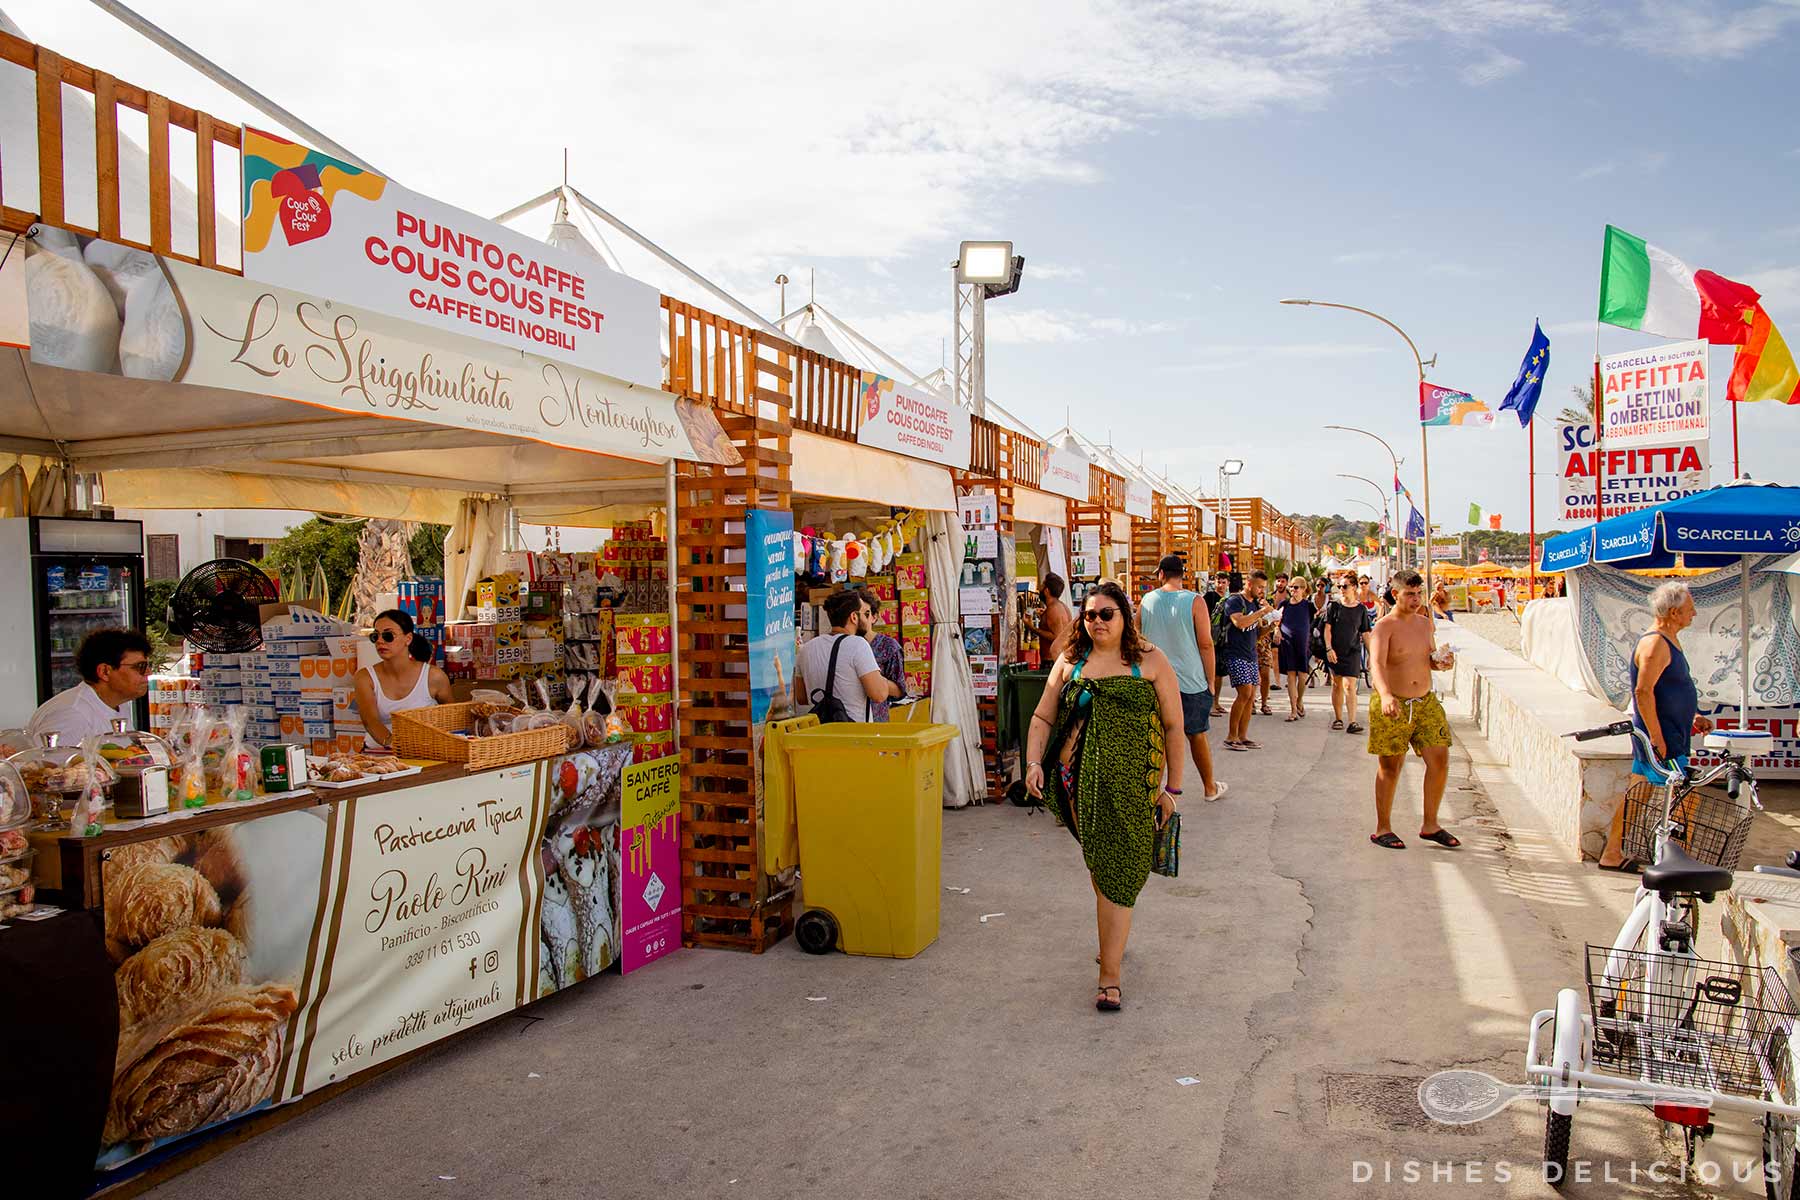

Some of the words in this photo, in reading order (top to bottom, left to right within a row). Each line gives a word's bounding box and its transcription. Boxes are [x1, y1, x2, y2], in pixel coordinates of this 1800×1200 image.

[287, 197, 309, 212] Cous
[295, 209, 317, 222] Cous
[291, 218, 310, 231] Fest
[396, 209, 501, 270] PUNTO
[364, 236, 462, 288] COUS
[467, 269, 545, 315] COUS
[549, 297, 605, 333] FEST
[200, 293, 296, 377] La
[485, 310, 516, 333] DEI
[519, 321, 576, 351] NOBILI
[1606, 356, 1657, 370] SCARCELLA
[1605, 360, 1705, 394] AFFITTA
[896, 394, 924, 416] PUNTO
[1626, 388, 1681, 408] LETTINI
[1610, 401, 1700, 425] OMBRELLONI
[887, 410, 912, 429] COUS
[913, 418, 936, 437] COUS
[936, 425, 953, 441] FEST
[1606, 423, 1656, 439] ABBONAMENTI
[1564, 446, 1703, 478] AFFITTA
[1601, 536, 1638, 550] SCARCELLA
[1677, 527, 1774, 541] SCARCELLA
[1548, 547, 1579, 562] SCARCELLA
[766, 586, 793, 610] Sicilia
[478, 612, 496, 620] 958
[498, 607, 520, 618] 958
[765, 619, 780, 637] con
[498, 647, 520, 659] 958
[275, 662, 290, 671] 958
[160, 691, 178, 699] 958
[627, 762, 680, 788] SANTERO
[636, 778, 670, 802] CAFFÈ
[374, 816, 477, 855] Pasticceria
[477, 798, 524, 834] Tipica
[364, 869, 447, 934] Paolo
[451, 847, 509, 906] Rini
[380, 923, 431, 951] Panificio
[440, 899, 499, 931] Biscottificio
[404, 950, 424, 970] 339
[427, 944, 437, 962] 11
[440, 938, 455, 956] 61
[458, 930, 481, 950] 530
[331, 1034, 365, 1066] solo
[371, 1009, 430, 1056] prodotti
[434, 980, 502, 1026] artigianali
